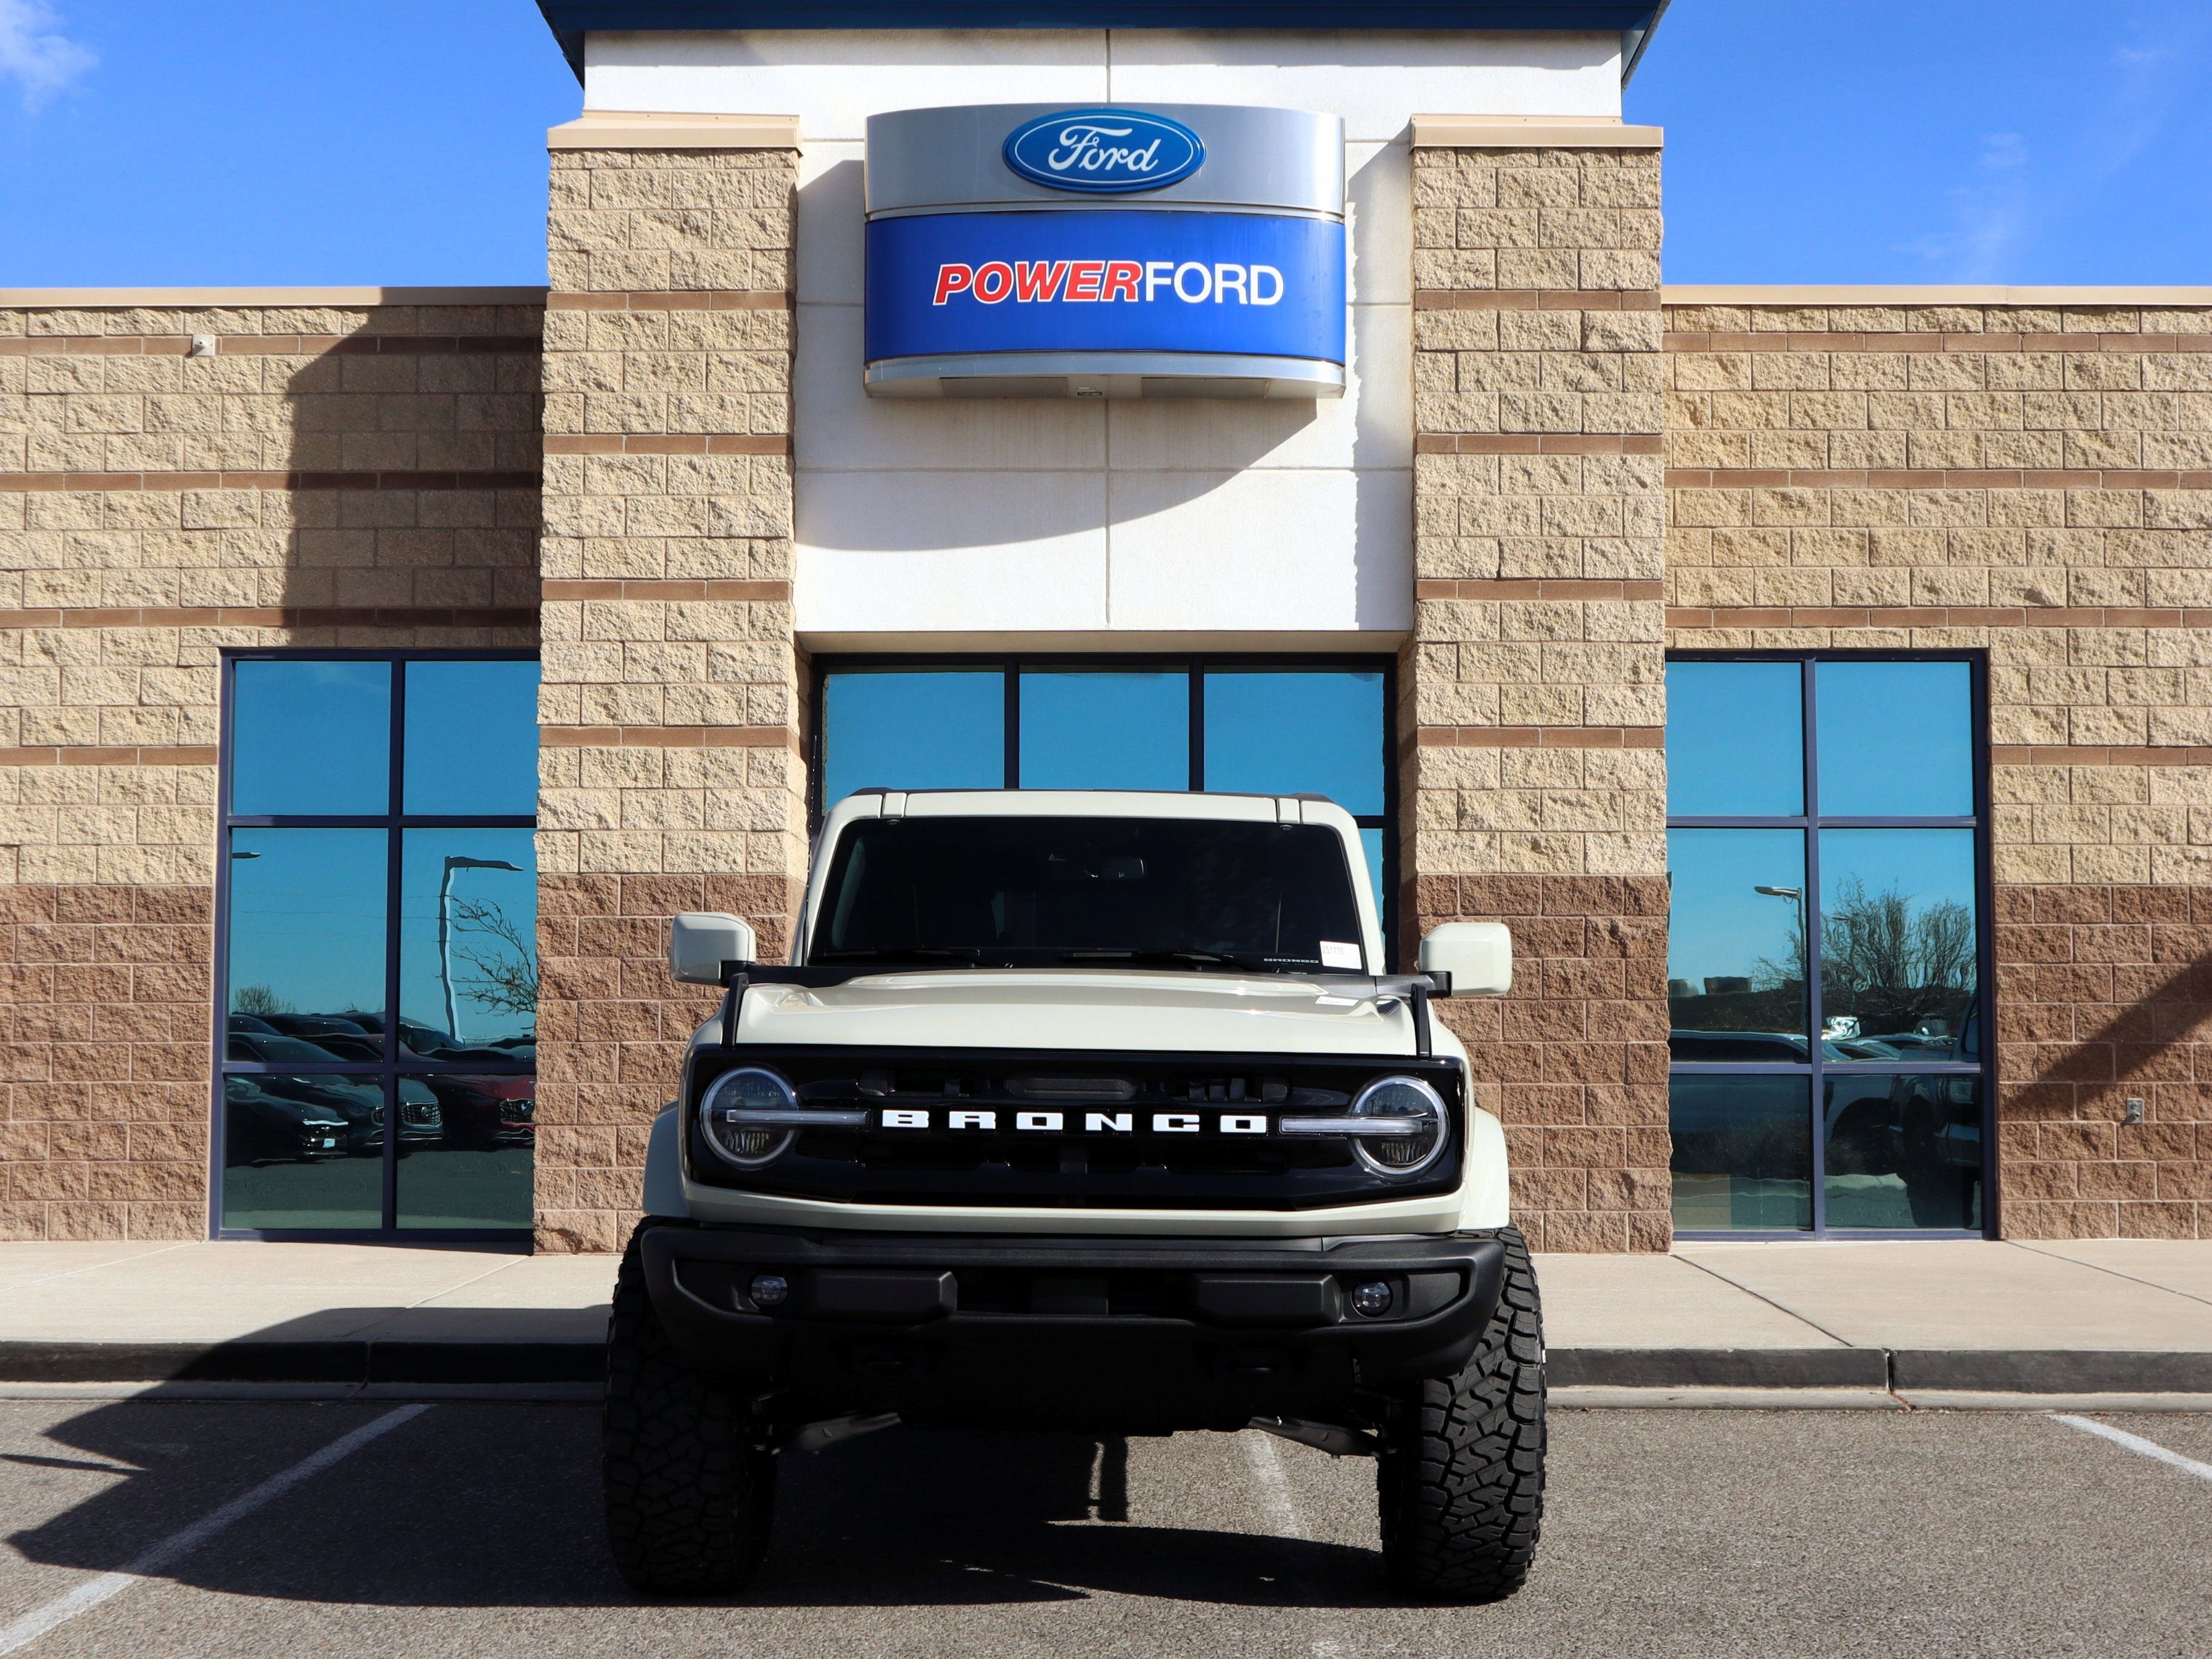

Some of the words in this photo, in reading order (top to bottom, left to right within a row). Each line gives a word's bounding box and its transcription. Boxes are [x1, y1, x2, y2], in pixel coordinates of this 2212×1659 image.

[1048, 125, 1161, 171] Ford
[1323, 946, 1344, 956] 251710
[882, 1109, 1267, 1133] BRONCO
